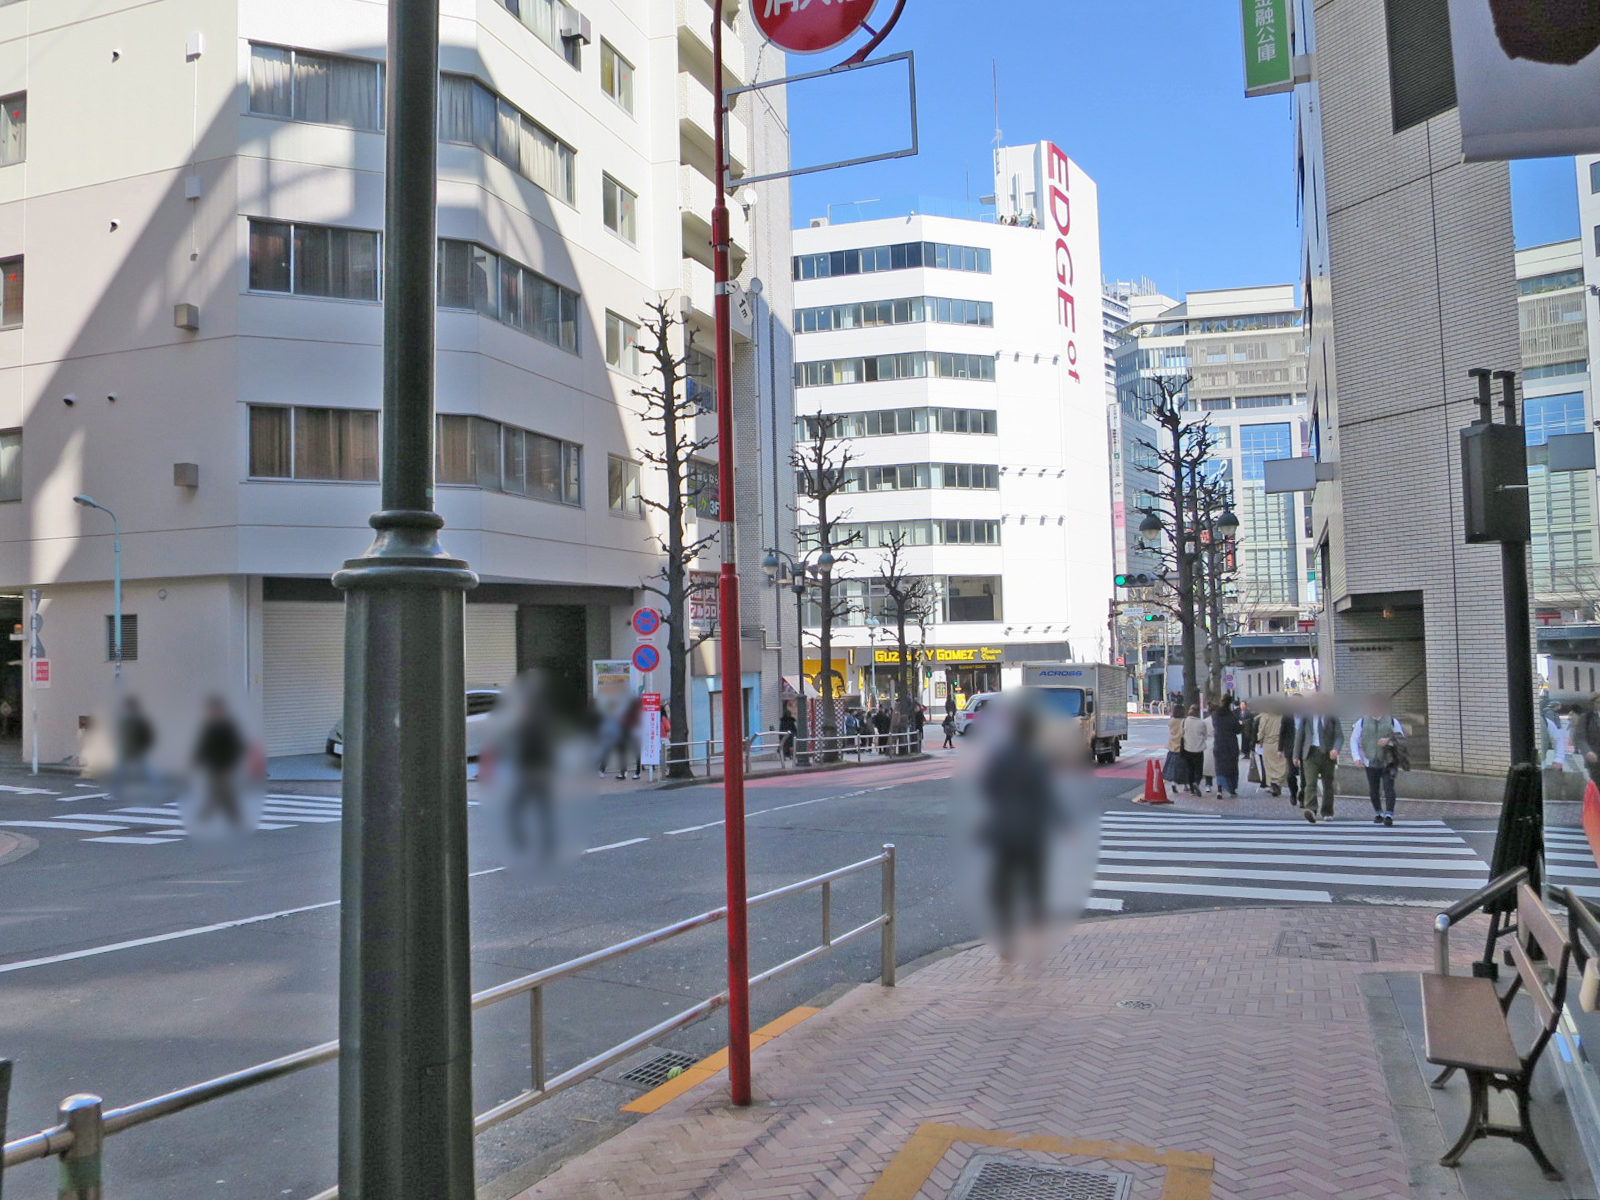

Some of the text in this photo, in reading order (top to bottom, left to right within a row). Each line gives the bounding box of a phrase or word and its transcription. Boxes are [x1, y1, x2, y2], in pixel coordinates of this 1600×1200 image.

[1047, 141, 1080, 384] EDGE of
[875, 649, 976, 663] GUZ Y GOMEZ
